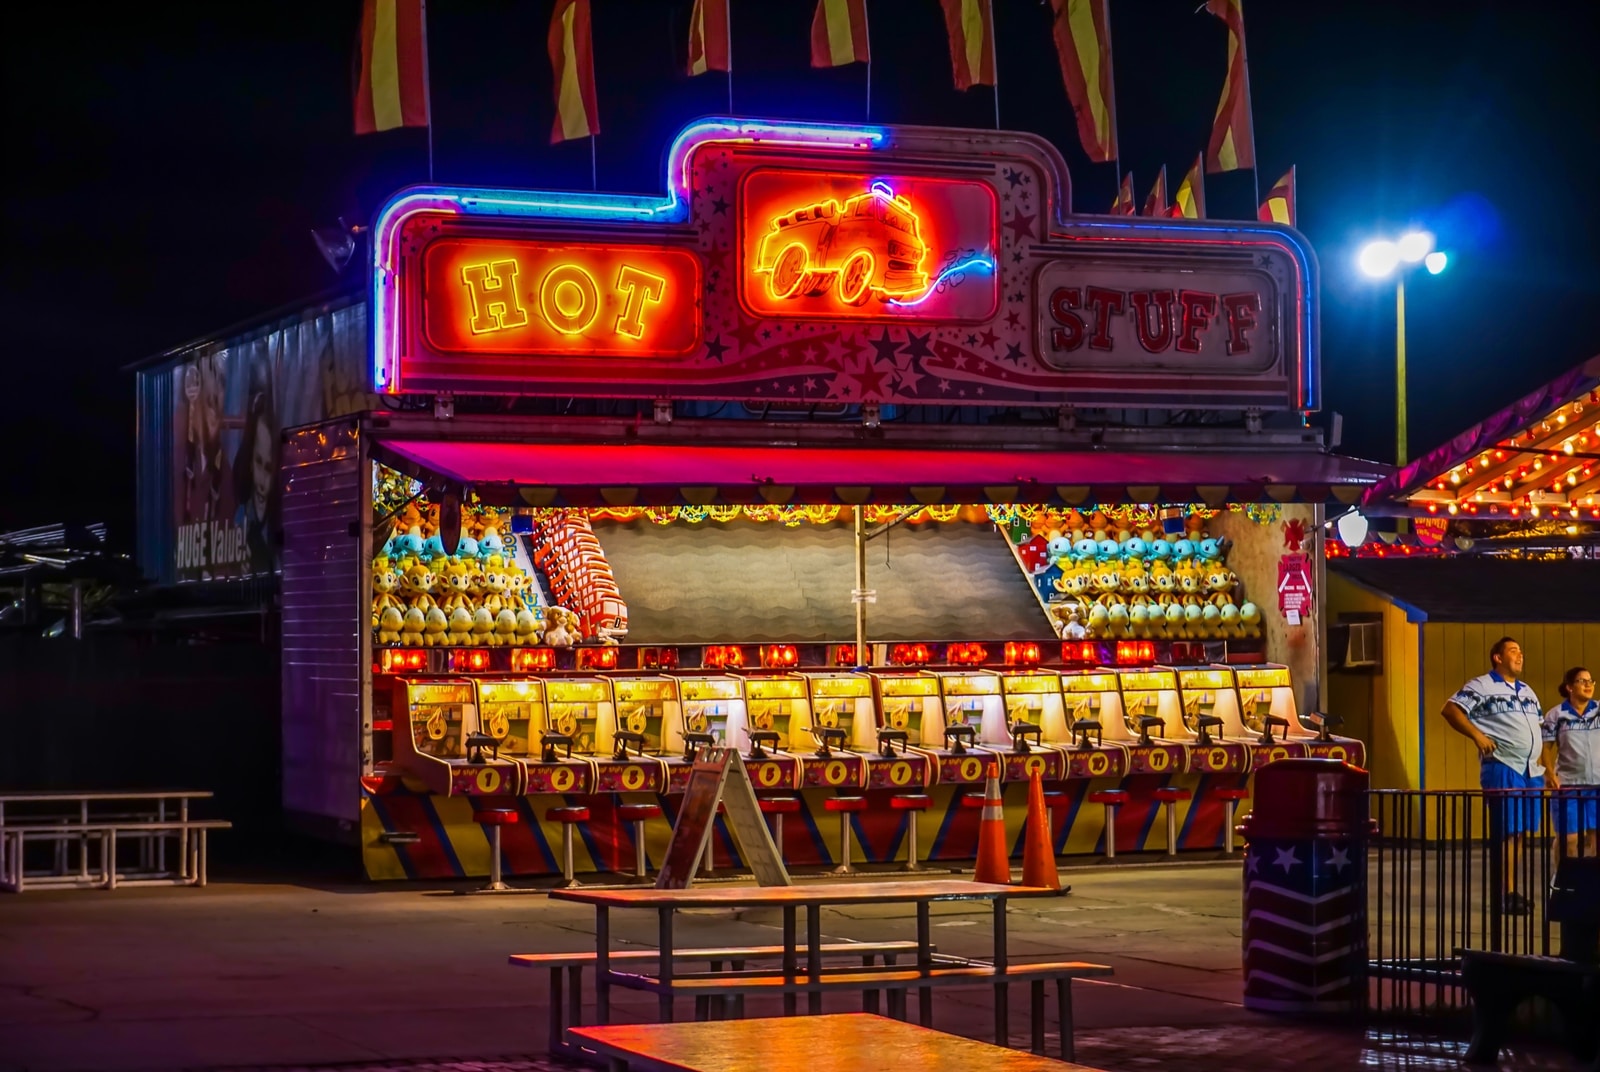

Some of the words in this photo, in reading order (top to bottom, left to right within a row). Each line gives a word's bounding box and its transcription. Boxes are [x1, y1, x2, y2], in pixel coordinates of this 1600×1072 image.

[461, 259, 665, 340] HOT
[1050, 285, 1263, 357] STUFF
[177, 523, 207, 568] HUGE
[211, 515, 247, 564] Value!
[1091, 756, 1106, 771] 10
[1153, 753, 1164, 766] 11
[1211, 751, 1225, 765] 12
[831, 765, 841, 780] 6
[897, 767, 905, 781] 7
[966, 762, 976, 777] 8
[485, 772, 493, 787] 1
[557, 770, 569, 785] 2
